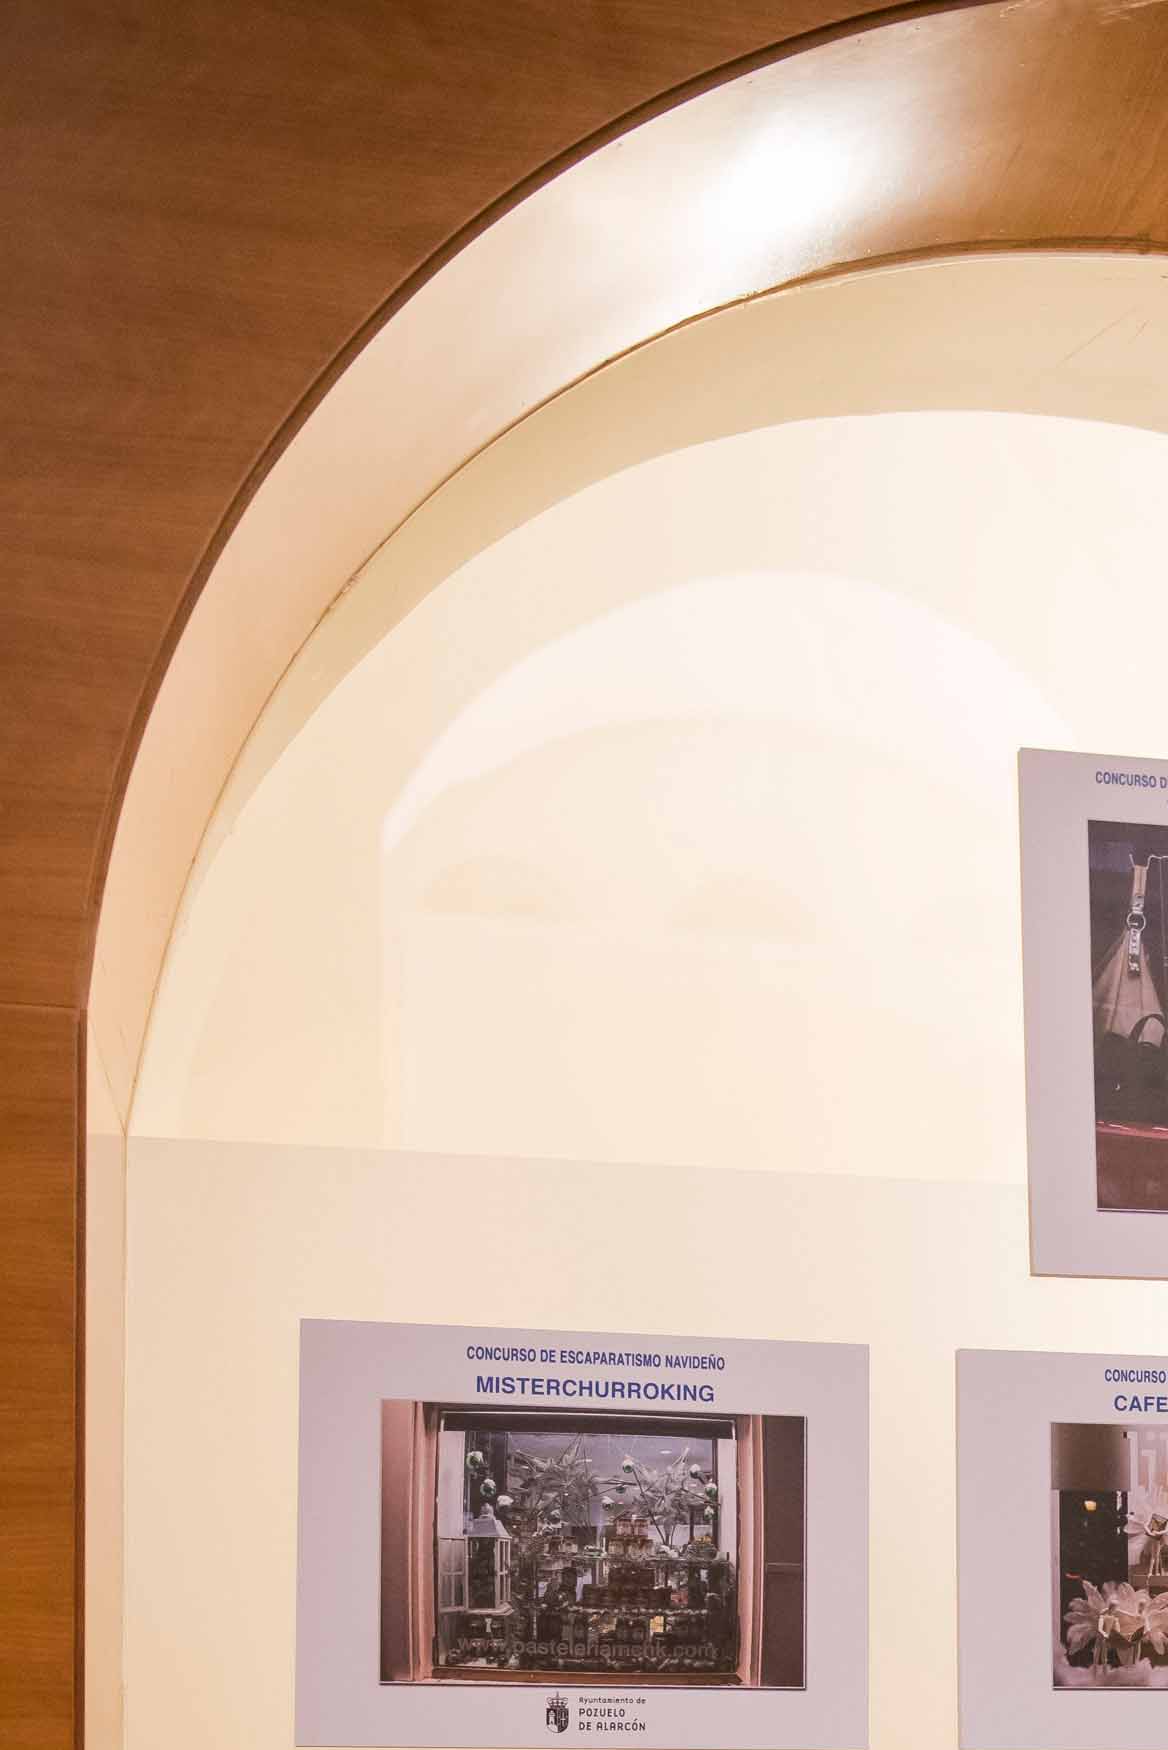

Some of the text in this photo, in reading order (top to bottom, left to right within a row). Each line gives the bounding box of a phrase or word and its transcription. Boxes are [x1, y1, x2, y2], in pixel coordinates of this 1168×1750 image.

[1095, 770, 1156, 788] CONCURSO
[466, 1345, 725, 1370] CONCURSO DE ESCAPARATISMO NAVIDEÑO
[1104, 1368, 1166, 1383] CONCURSO
[476, 1375, 714, 1402] MISTERCHURROKING
[578, 1696, 646, 1705] Ayuntamiento de
[578, 1707, 625, 1717] POZUELO
[578, 1718, 645, 1731] DE ALARCÓN
